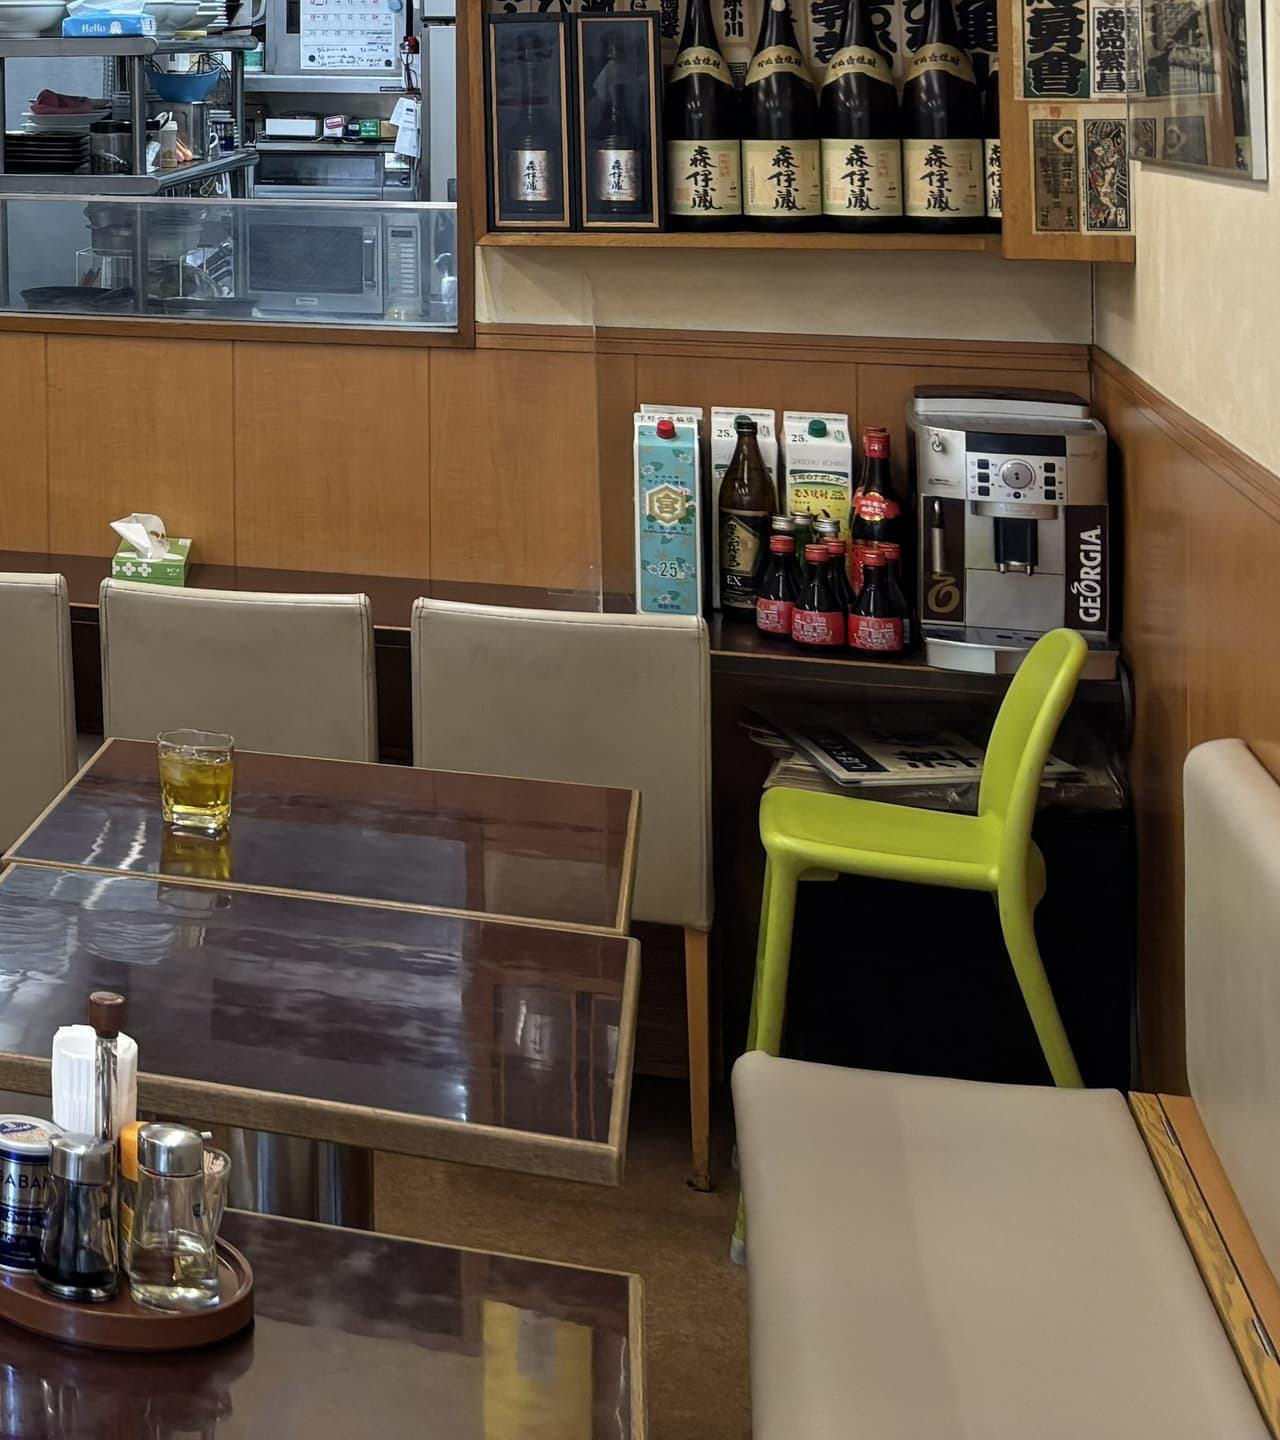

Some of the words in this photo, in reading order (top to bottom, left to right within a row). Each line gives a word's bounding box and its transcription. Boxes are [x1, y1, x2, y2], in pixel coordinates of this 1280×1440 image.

[81, 23, 106, 33] Hello
[659, 562, 678, 578] 25
[1071, 528, 1102, 622] GEORGIA
[727, 575, 742, 586] EX
